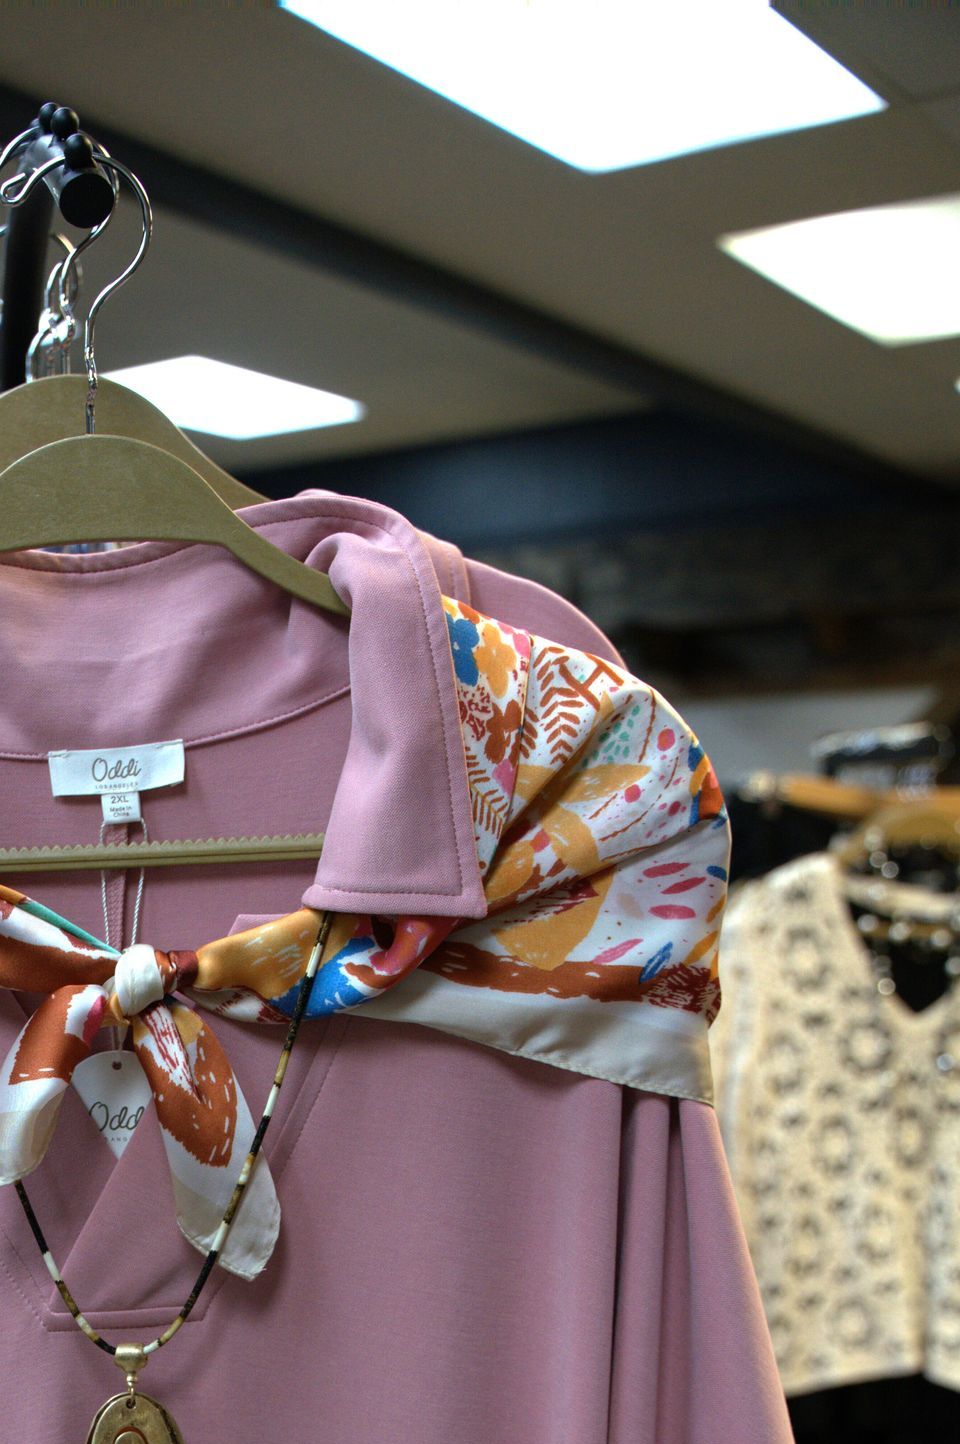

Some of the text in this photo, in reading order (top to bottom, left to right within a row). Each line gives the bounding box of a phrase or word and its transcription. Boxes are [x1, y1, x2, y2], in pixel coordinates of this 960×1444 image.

[92, 758, 142, 782] Oddi
[111, 795, 129, 804] 2XL
[89, 1101, 145, 1131] Odd
